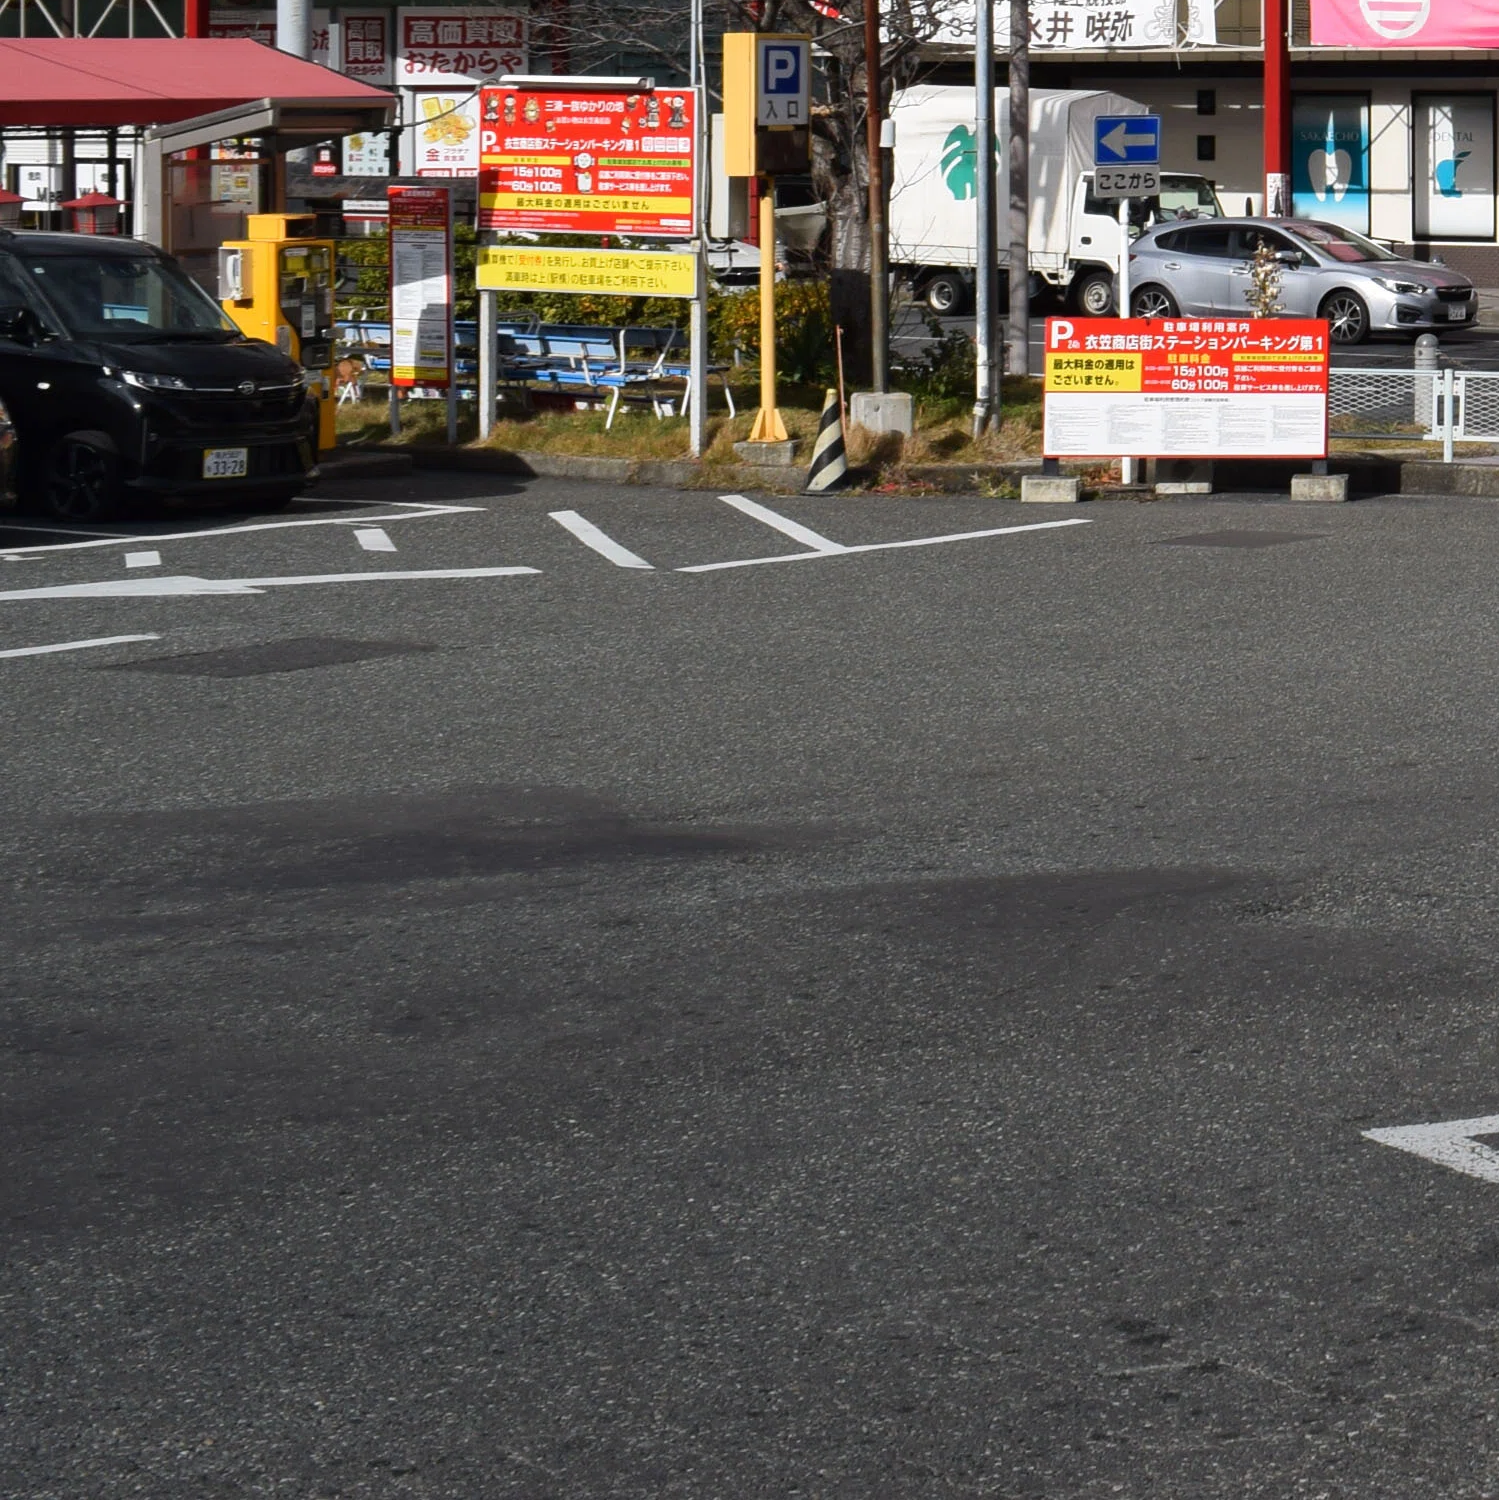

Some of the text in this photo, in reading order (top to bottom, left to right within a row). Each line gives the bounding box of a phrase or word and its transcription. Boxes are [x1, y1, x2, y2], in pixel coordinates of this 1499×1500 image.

[409, 20, 521, 46] 高価買取
[404, 51, 523, 75] おたからや
[768, 50, 796, 90] P
[766, 101, 799, 119] 入口
[481, 131, 497, 151] P
[1434, 131, 1474, 142] DENTAL
[1099, 173, 1156, 190] ここから
[1051, 321, 1074, 349] P
[1053, 359, 1135, 371] 最大料金の適用は
[1173, 365, 1229, 377] 15分100円
[1171, 379, 1229, 391] 60分100円
